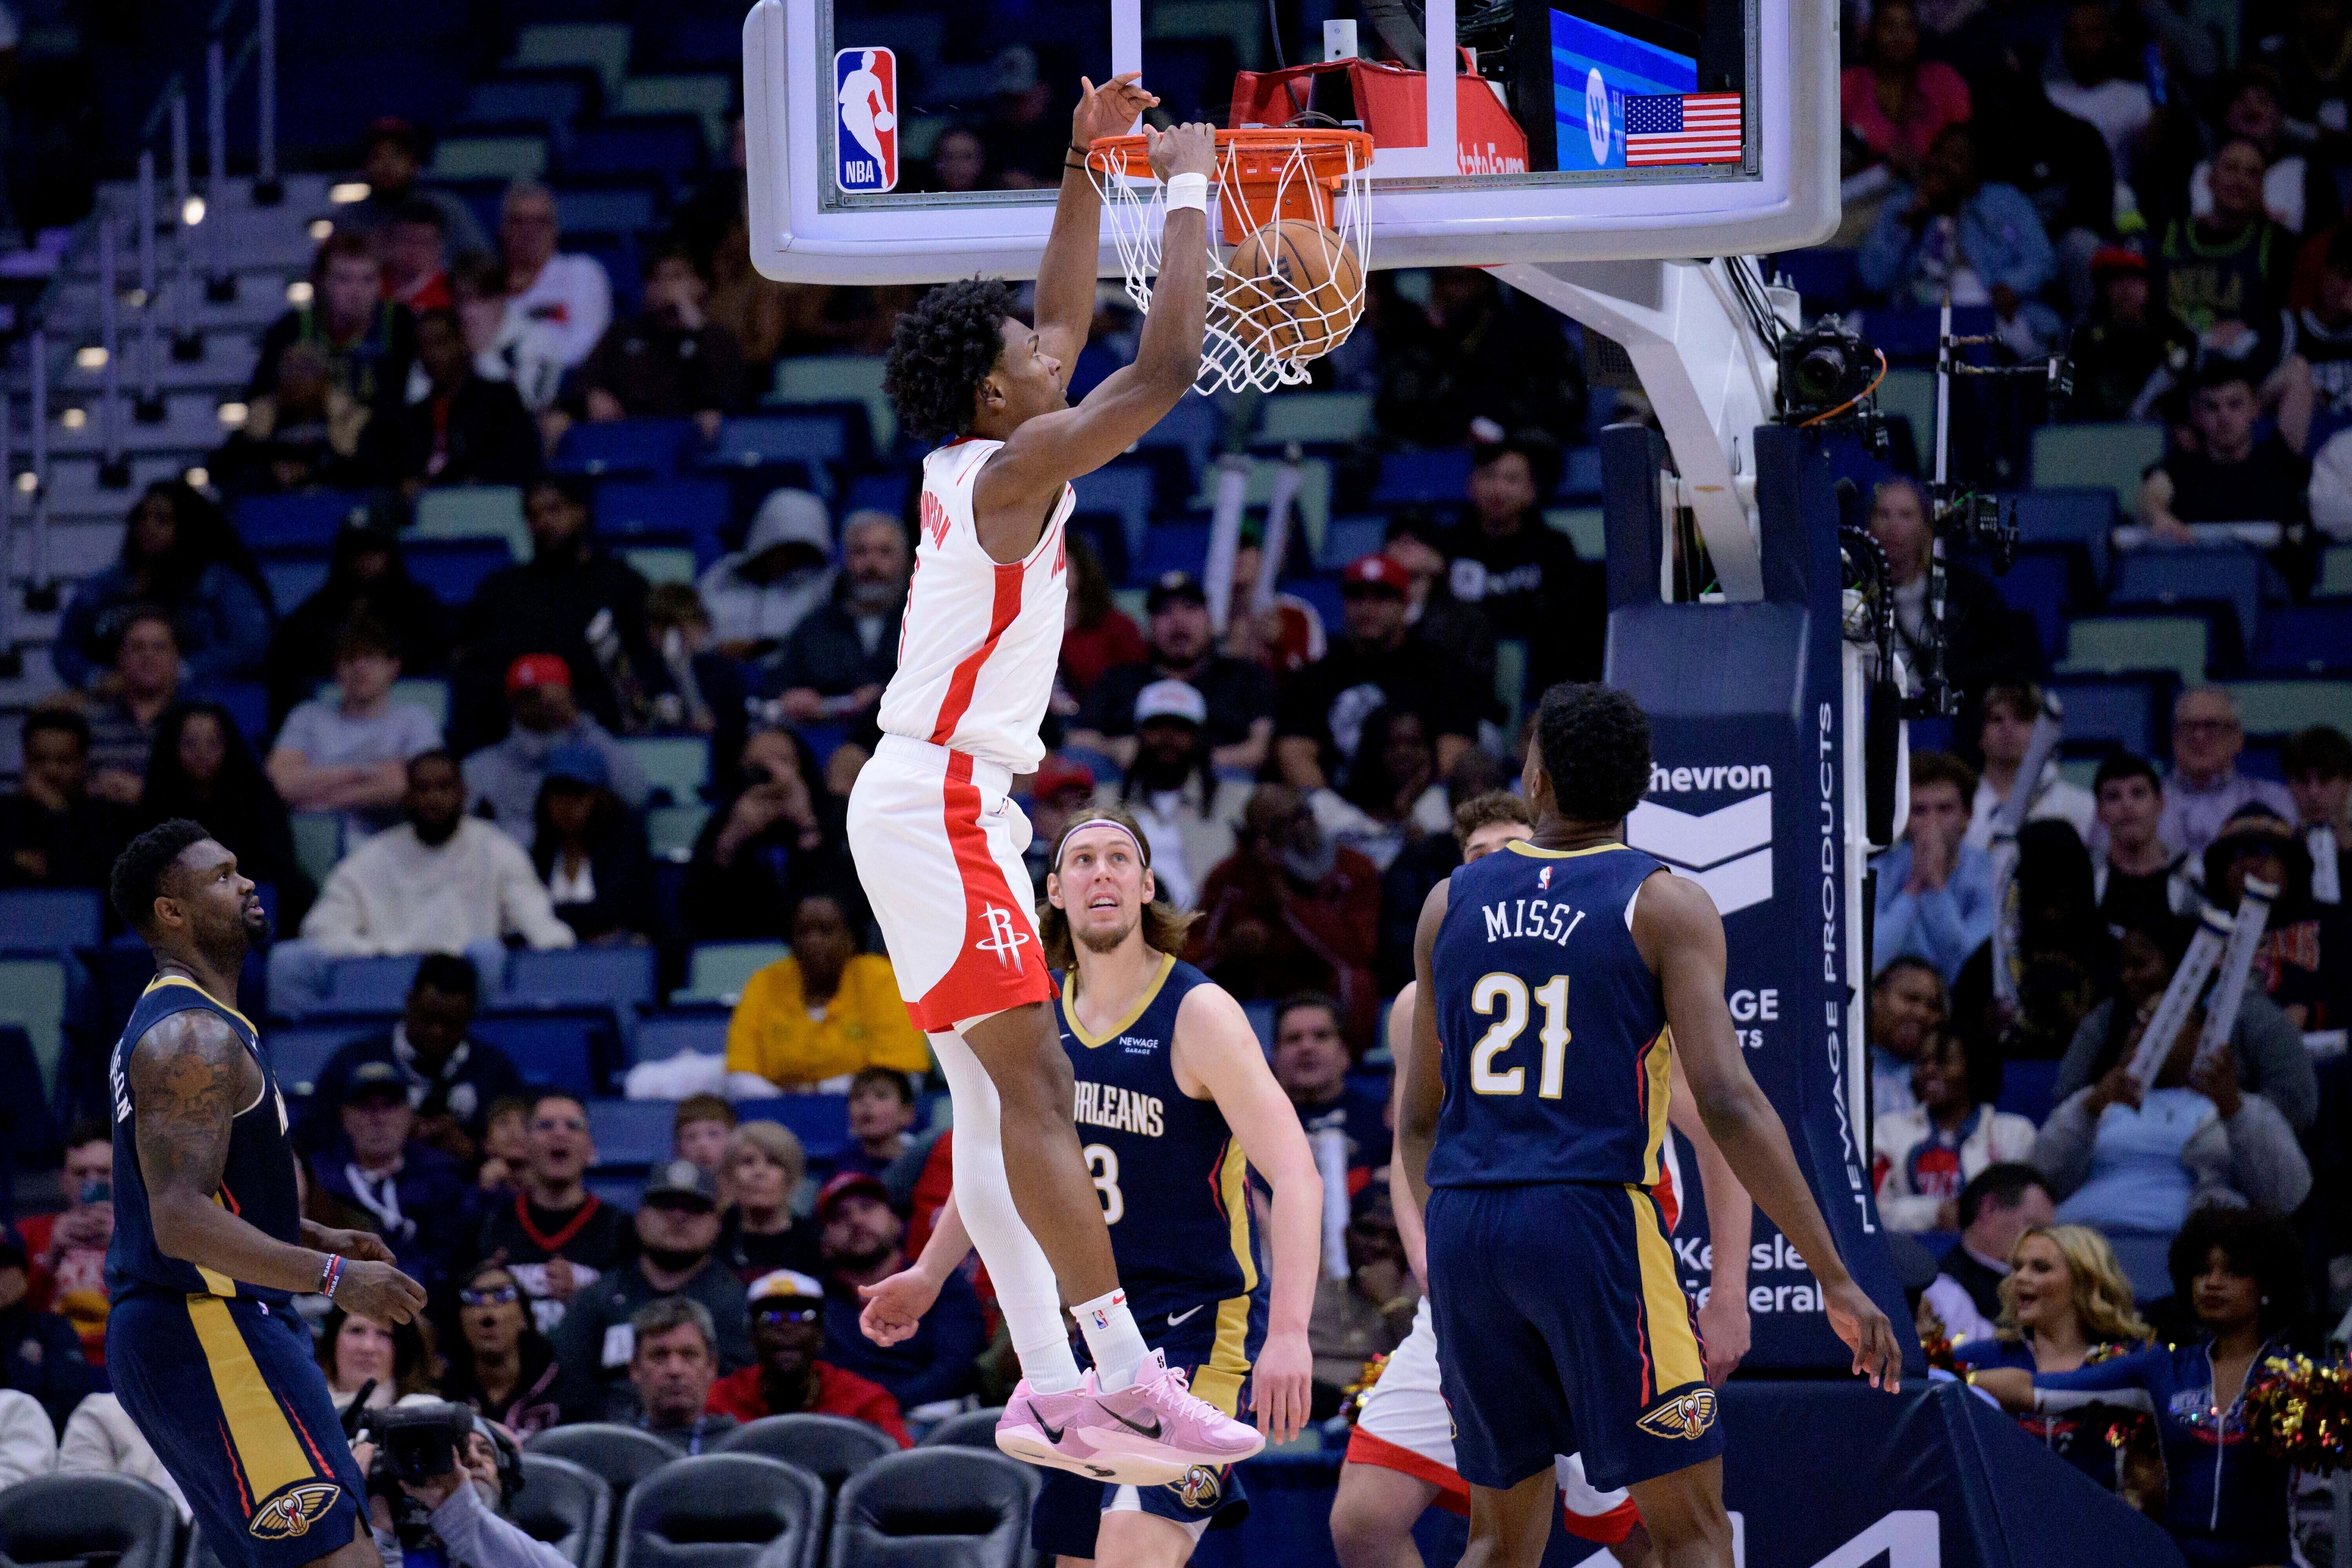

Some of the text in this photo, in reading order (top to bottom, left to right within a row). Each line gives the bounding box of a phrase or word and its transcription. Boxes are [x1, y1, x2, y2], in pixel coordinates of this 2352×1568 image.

[846, 160, 874, 183] NBA
[1649, 761, 1771, 792] hevron
[1819, 702, 1836, 982] PRODUCTS
[1482, 899, 1586, 947] MISSI
[1119, 1036, 1159, 1048] NEWAGE
[1470, 972, 1572, 1099] 21
